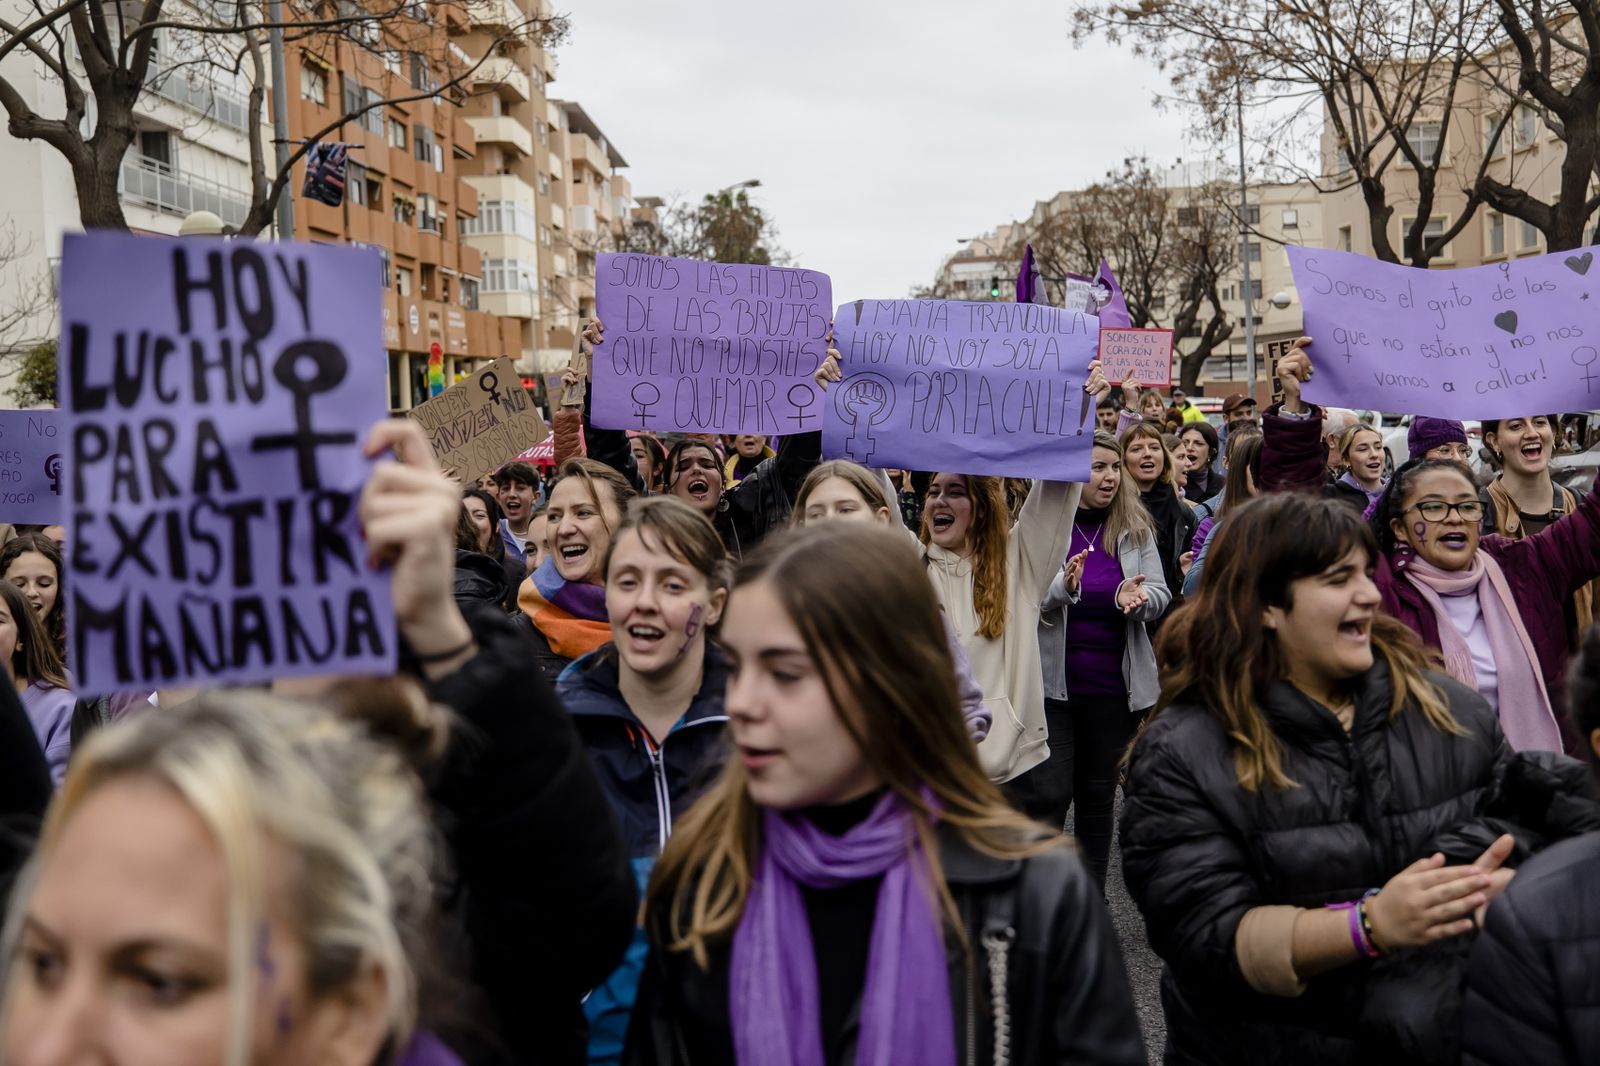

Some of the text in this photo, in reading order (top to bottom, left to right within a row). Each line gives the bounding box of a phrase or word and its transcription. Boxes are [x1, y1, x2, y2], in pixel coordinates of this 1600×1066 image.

[172, 246, 313, 343] HOY
[609, 256, 818, 300] SOMOS LAS HIJAS
[1305, 258, 1557, 330] Somos el grito de las
[626, 294, 827, 340] DE LAS BRUJAS
[963, 303, 1088, 335] TRANQUILA
[1144, 335, 1158, 344] EL
[69, 322, 267, 415] LUCHO
[612, 336, 819, 378] QUE NO PUDISTEIS
[850, 331, 1061, 372] HOY NO VOY SOLA
[1103, 357, 1166, 368] DE LAS QUE YA
[1268, 340, 1296, 358] FE
[1333, 325, 1584, 369] que no están y no nos
[673, 376, 780, 432] QUEMAR
[904, 371, 1092, 436] POR LA CALLE!
[1442, 381, 1456, 393] a
[428, 402, 501, 459] MUJER
[501, 386, 529, 417] NO
[72, 418, 238, 504] PARA
[2, 492, 35, 505] YOGA
[72, 490, 359, 590] EXISTIR
[72, 586, 386, 690] MAÑANA
